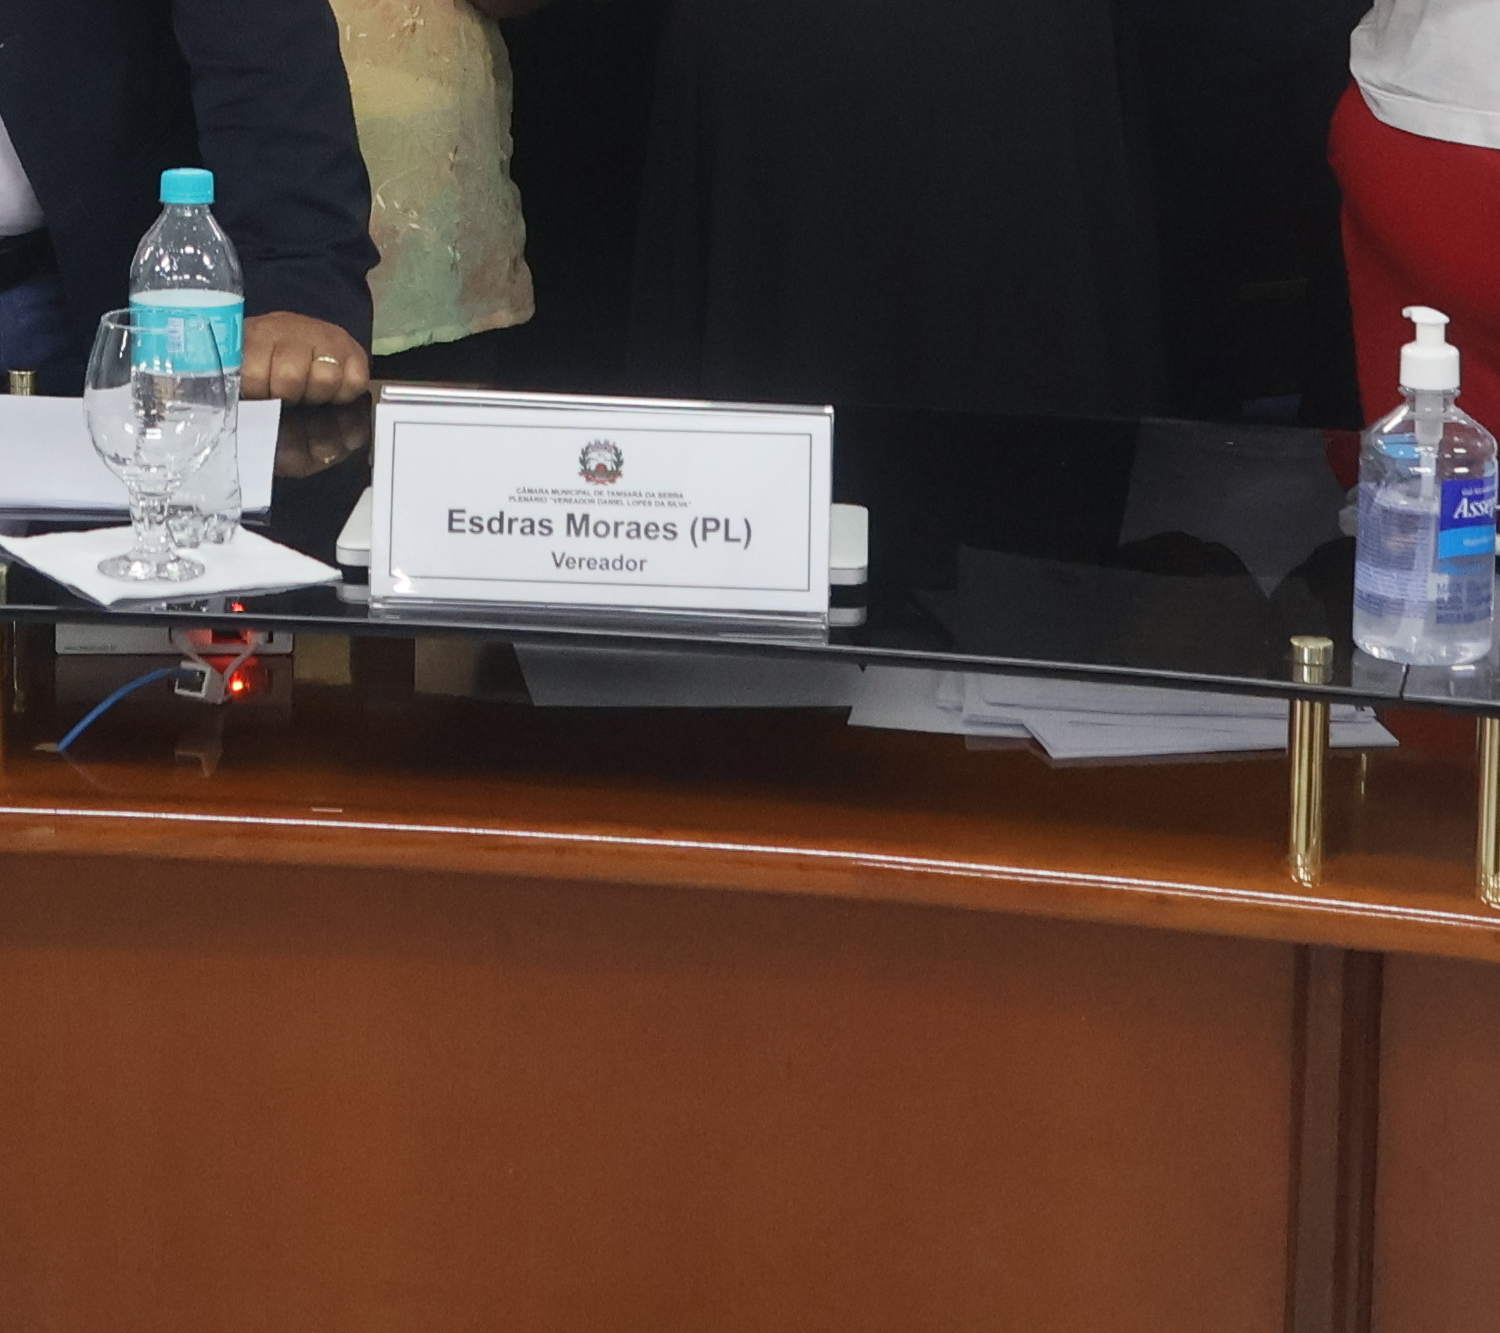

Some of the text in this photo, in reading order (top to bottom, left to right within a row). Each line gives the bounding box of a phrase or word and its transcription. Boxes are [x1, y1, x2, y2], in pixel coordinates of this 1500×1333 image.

[447, 508, 752, 550] Esdras Moraes (PL)
[551, 551, 648, 572] Vereador
